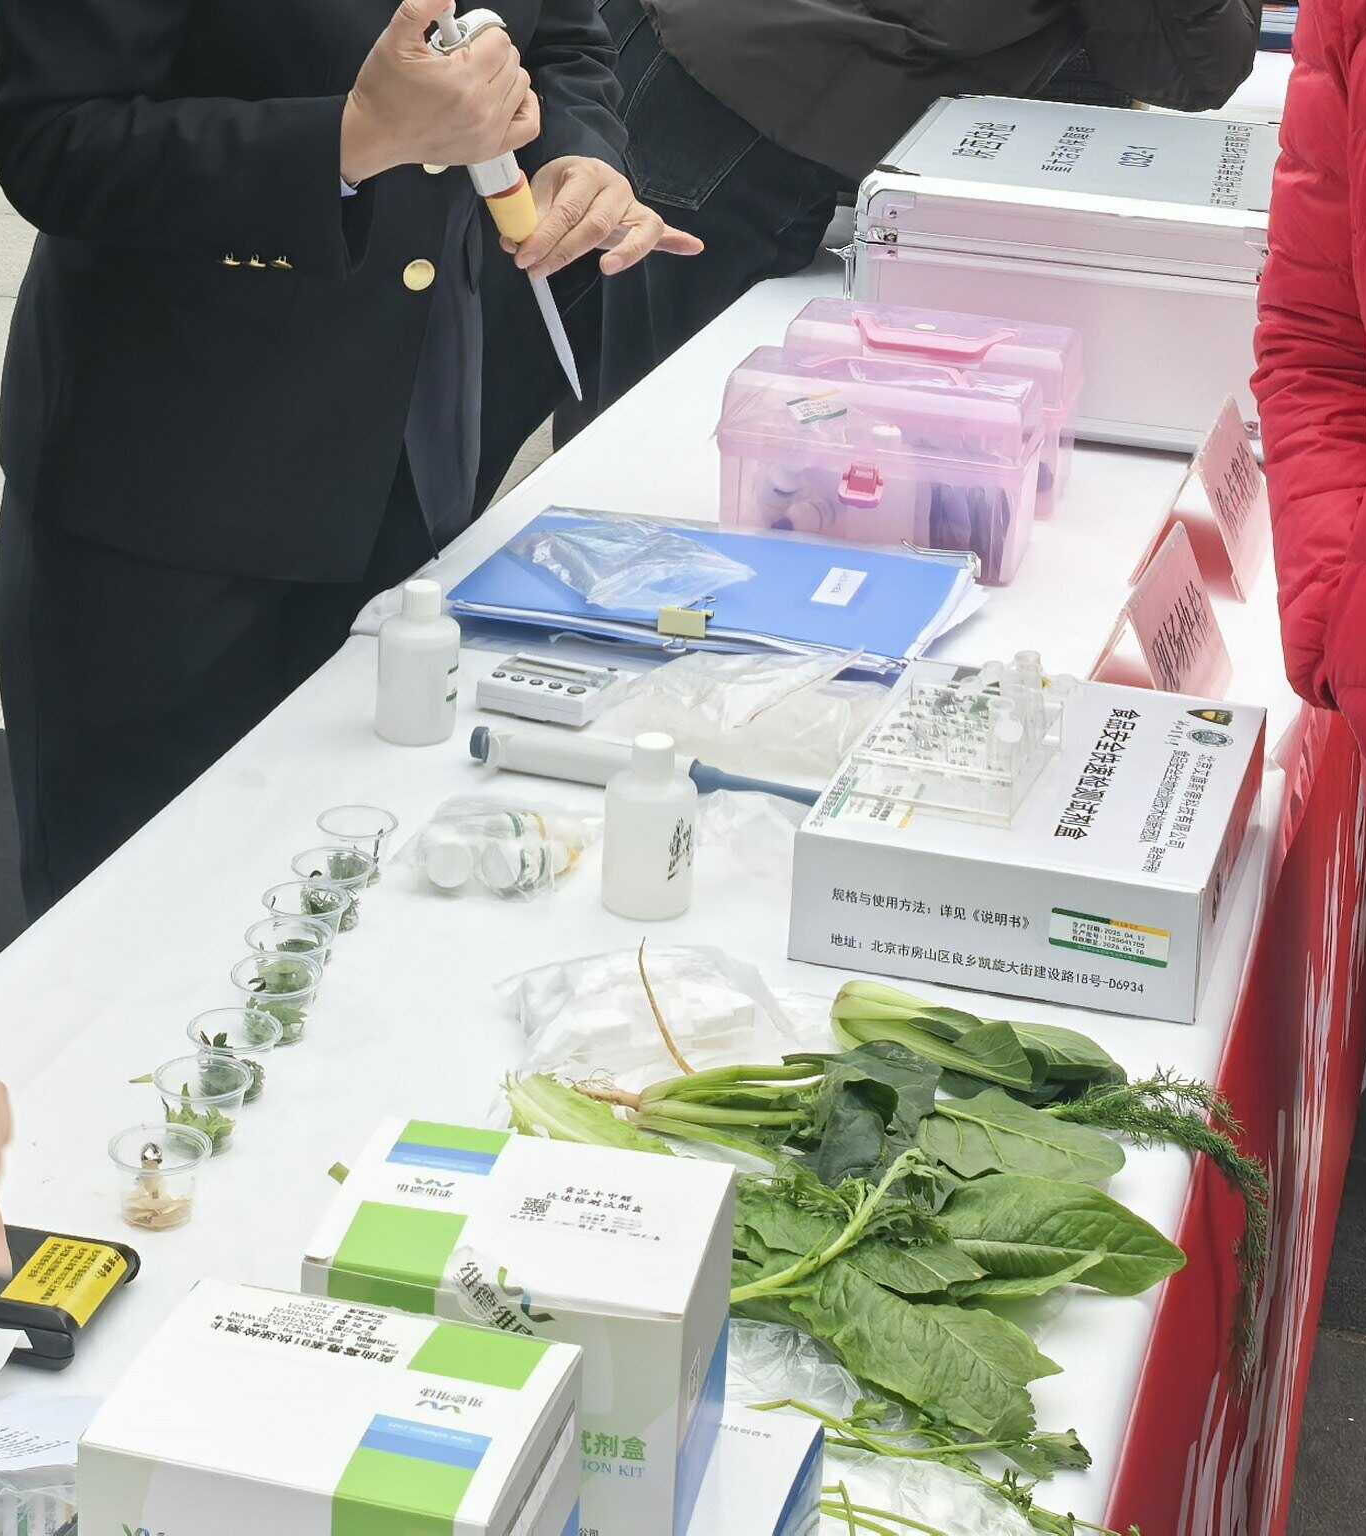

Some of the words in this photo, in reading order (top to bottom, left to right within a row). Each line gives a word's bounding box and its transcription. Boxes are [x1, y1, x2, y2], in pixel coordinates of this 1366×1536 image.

[1117, 145, 1159, 169] 032-1
[1054, 708, 1141, 840] 食品安全快速检测试剂盒
